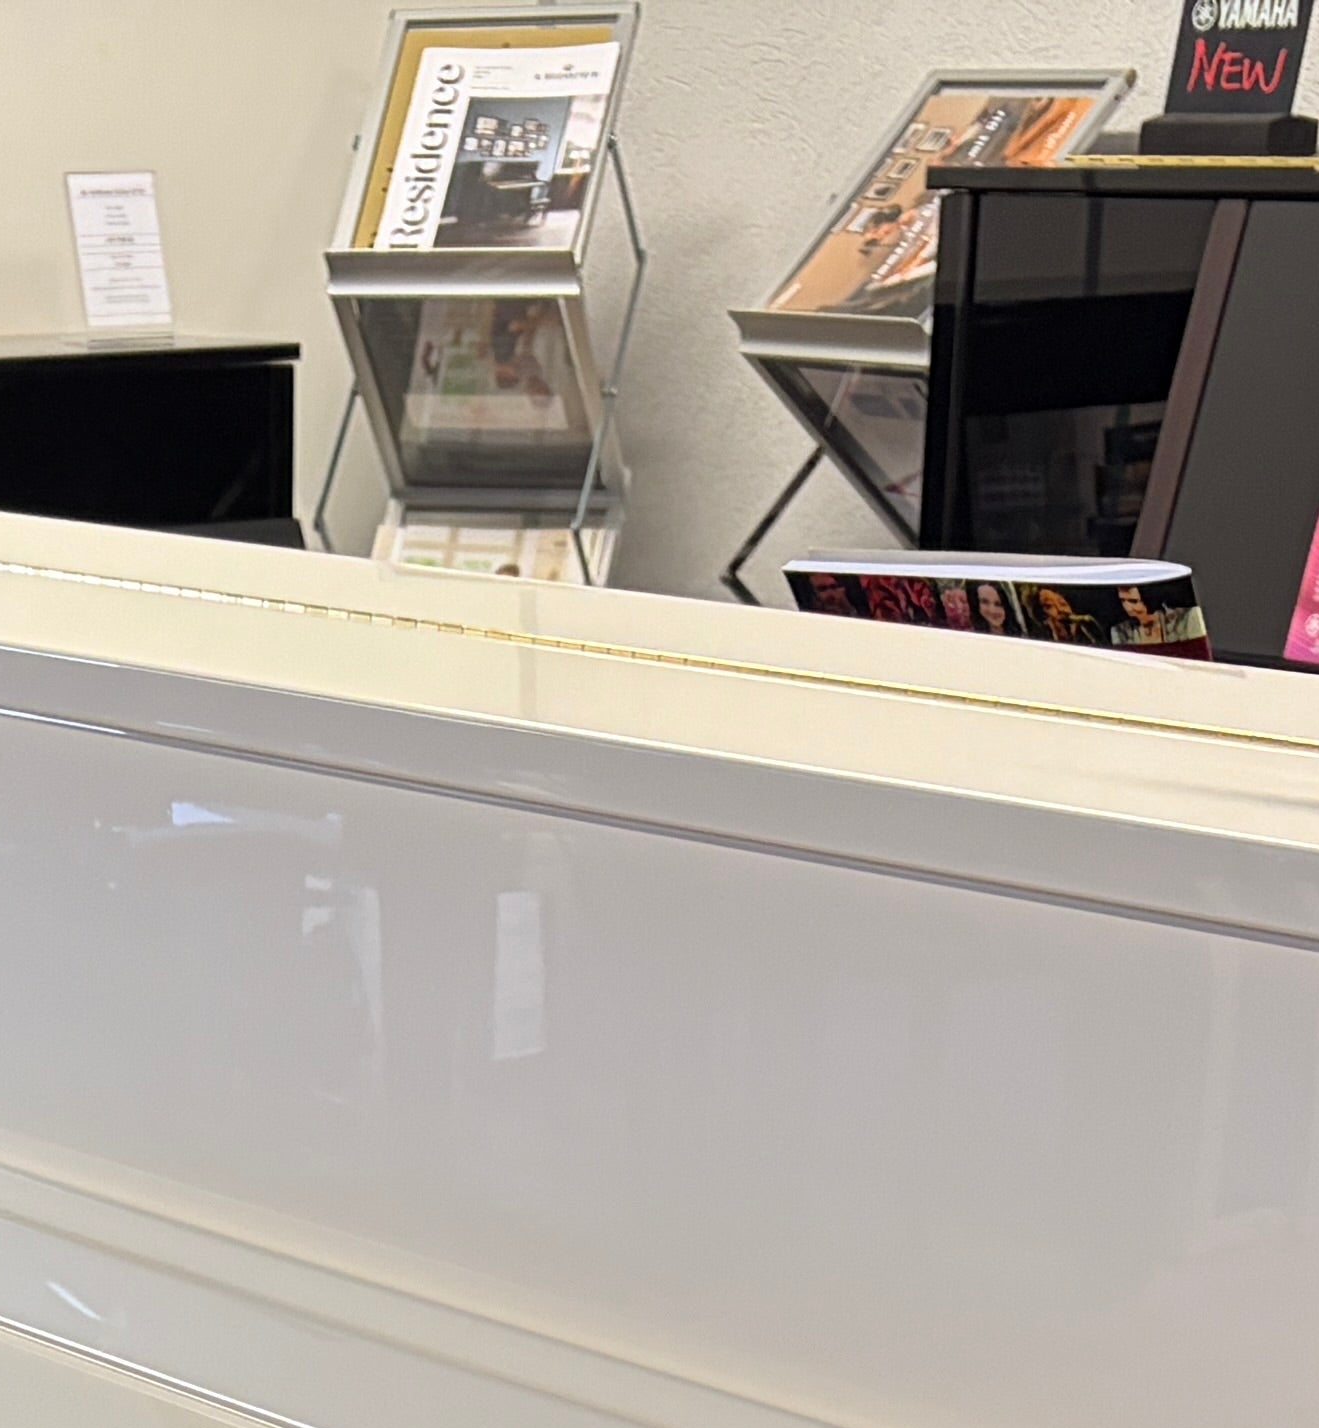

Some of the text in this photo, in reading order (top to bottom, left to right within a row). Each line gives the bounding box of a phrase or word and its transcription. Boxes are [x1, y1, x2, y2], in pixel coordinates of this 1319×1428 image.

[1218, 0, 1298, 29] YAMAHA
[1186, 37, 1288, 94] NEW
[389, 63, 465, 248] Residence
